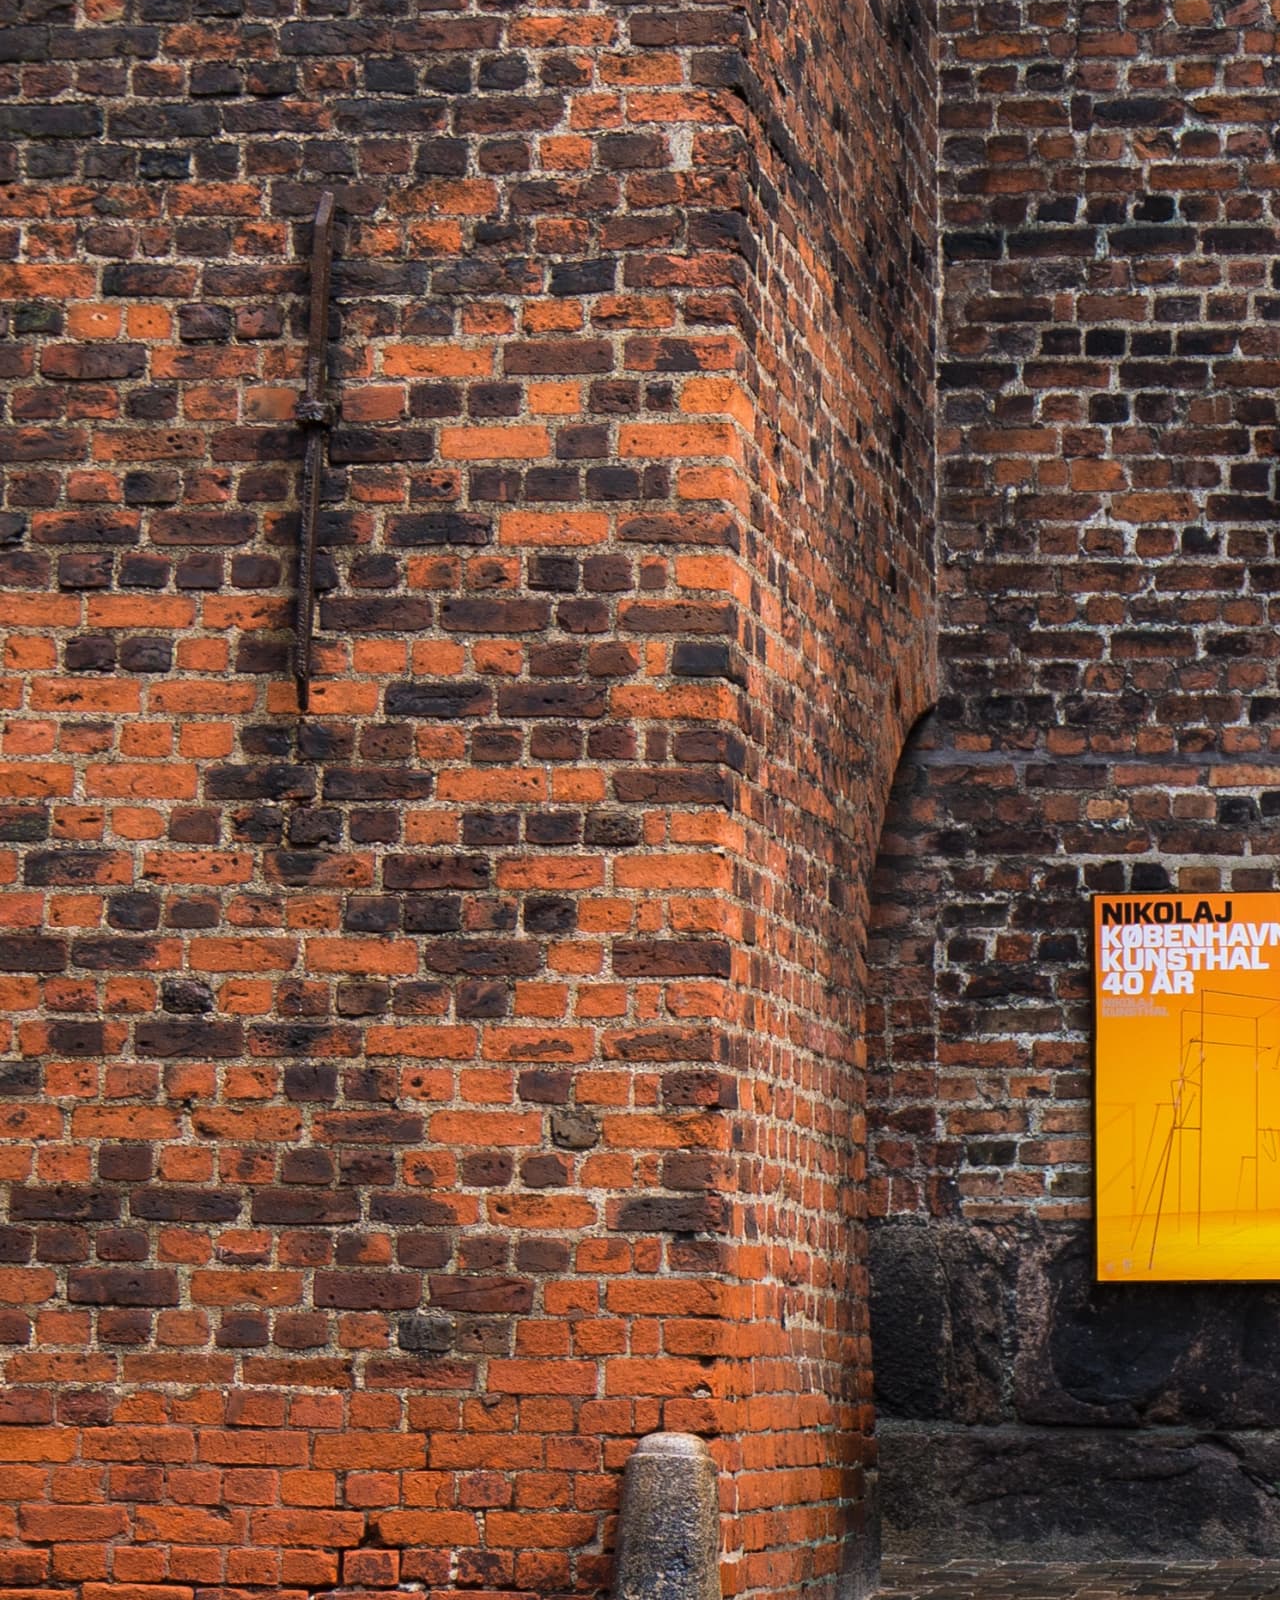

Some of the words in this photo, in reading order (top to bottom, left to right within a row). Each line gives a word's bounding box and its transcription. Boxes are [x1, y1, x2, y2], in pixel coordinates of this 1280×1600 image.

[1101, 901, 1232, 925] NIKOLAJ
[1101, 946, 1269, 972] KUNSTHAL
[1101, 972, 1144, 995] 40
[1151, 967, 1194, 994] ÅR
